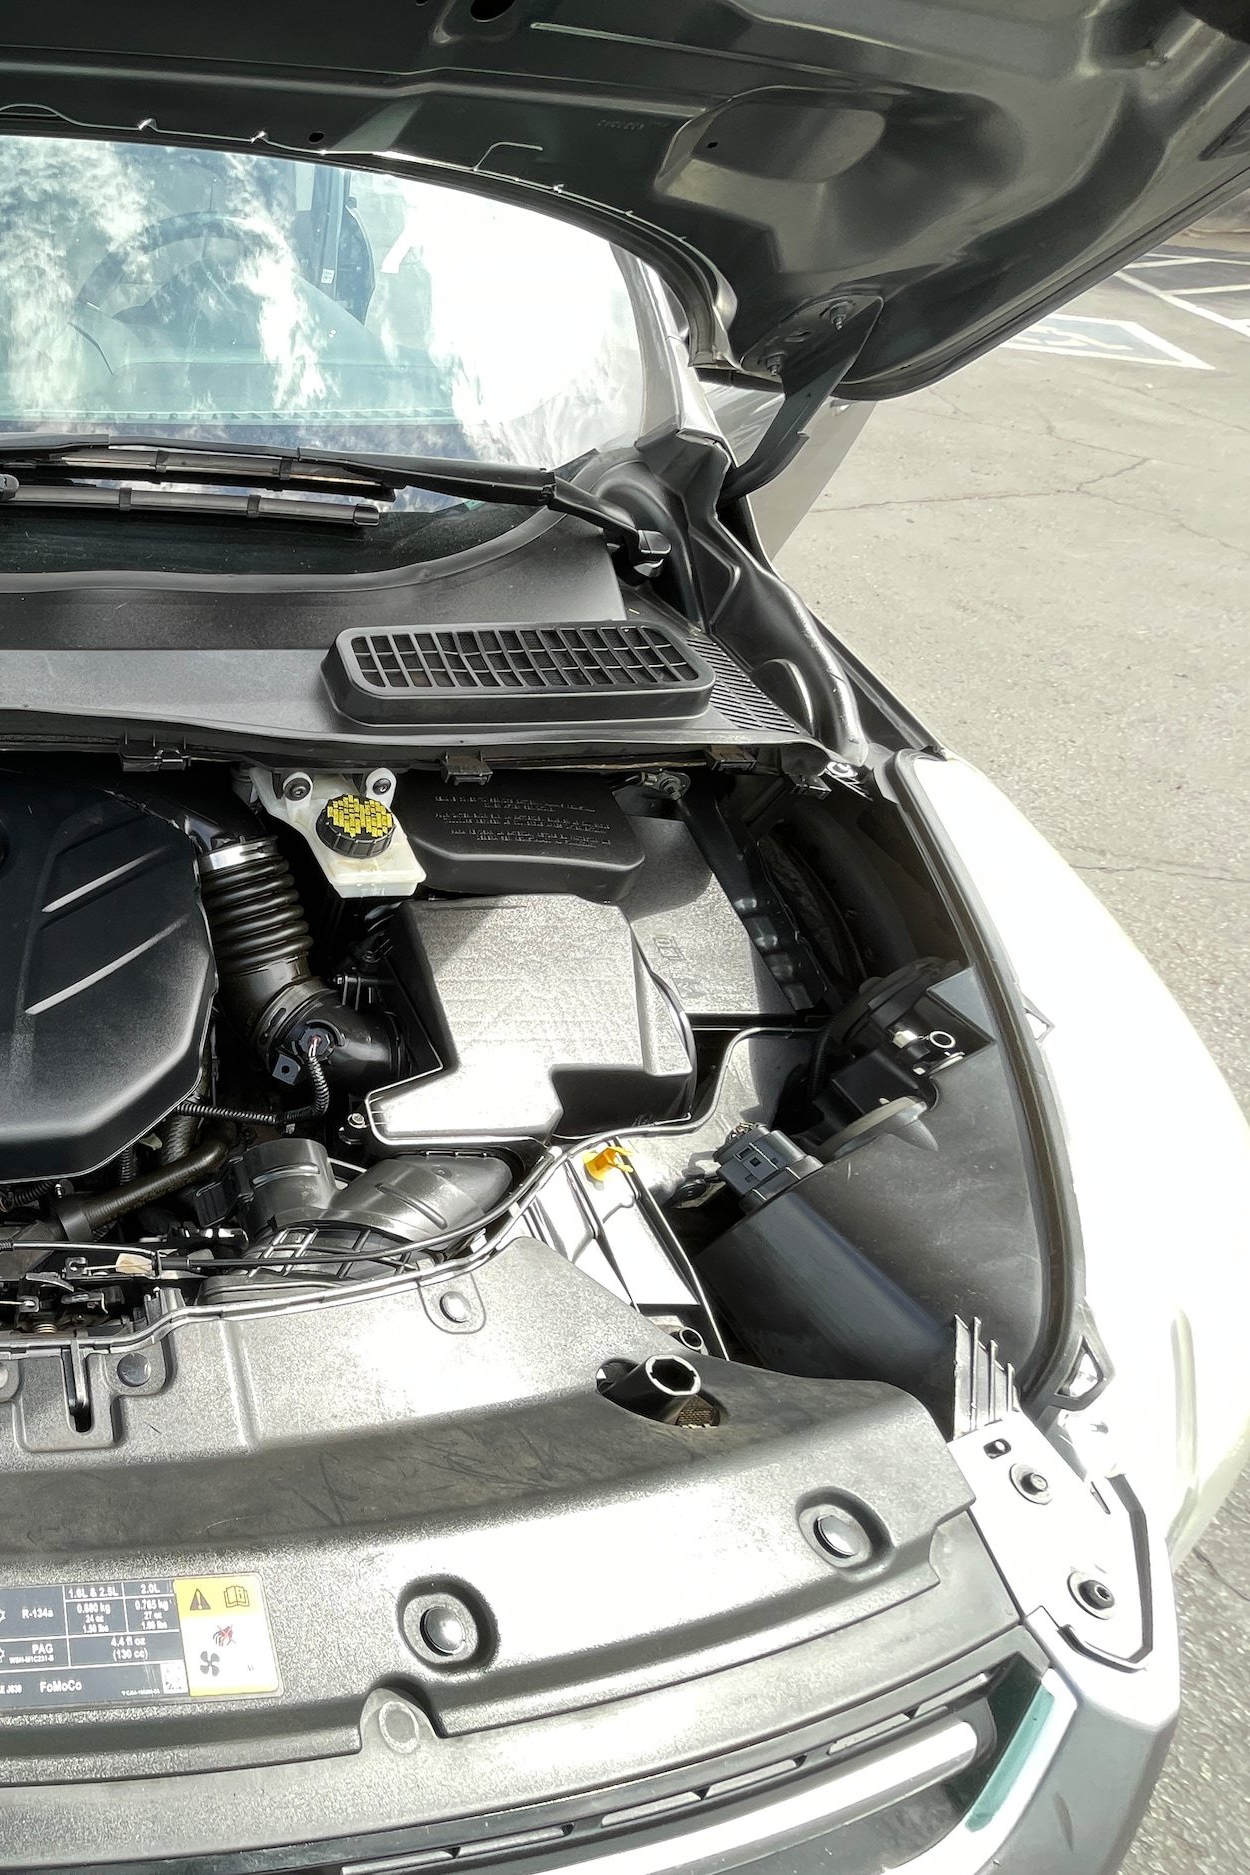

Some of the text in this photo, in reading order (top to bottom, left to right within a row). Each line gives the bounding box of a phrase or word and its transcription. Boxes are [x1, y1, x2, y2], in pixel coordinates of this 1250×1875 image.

[140, 1583, 160, 1595] 2.0L
[99, 1602, 111, 1614] kg
[158, 1599, 169, 1611] kg
[21, 1608, 54, 1619] R-134a
[110, 1637, 125, 1647] 4.4
[134, 1637, 146, 1646] oz
[31, 1643, 54, 1655] PAG
[112, 1647, 149, 1662] (130 cc)
[39, 1680, 83, 1693] FoMoCo
